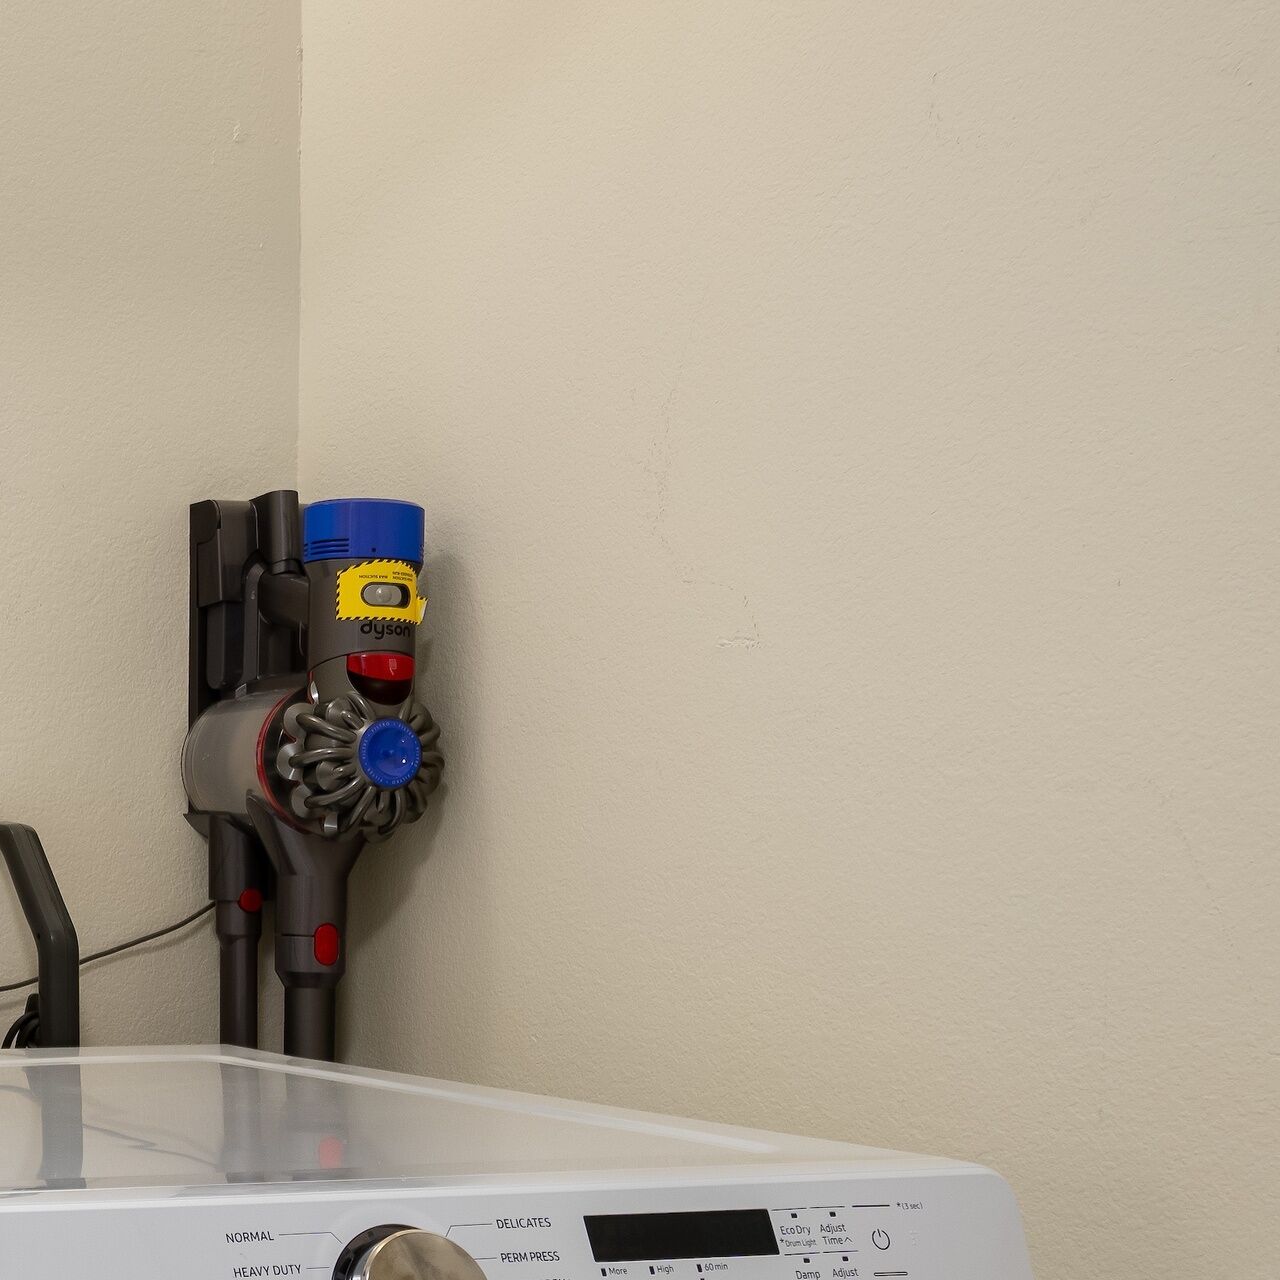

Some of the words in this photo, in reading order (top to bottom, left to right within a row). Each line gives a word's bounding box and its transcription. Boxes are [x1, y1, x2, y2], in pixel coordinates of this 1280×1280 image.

[360, 619, 410, 640] dyson
[496, 1217, 552, 1229] DELICATES
[780, 1226, 795, 1235] Eco
[796, 1225, 811, 1236] Dry
[820, 1224, 846, 1234] Adjust
[226, 1231, 274, 1243] NORMAL
[822, 1236, 843, 1245] Time
[802, 1238, 816, 1248] Light
[500, 1253, 528, 1263] PERM
[530, 1251, 560, 1262] PRESS
[233, 1266, 270, 1278] HEAVY
[272, 1264, 302, 1276] DUTY
[609, 1267, 627, 1275] More
[657, 1265, 674, 1274] High
[715, 1263, 728, 1271] min
[796, 1271, 821, 1280] Damp
[832, 1268, 858, 1278] Adjust
